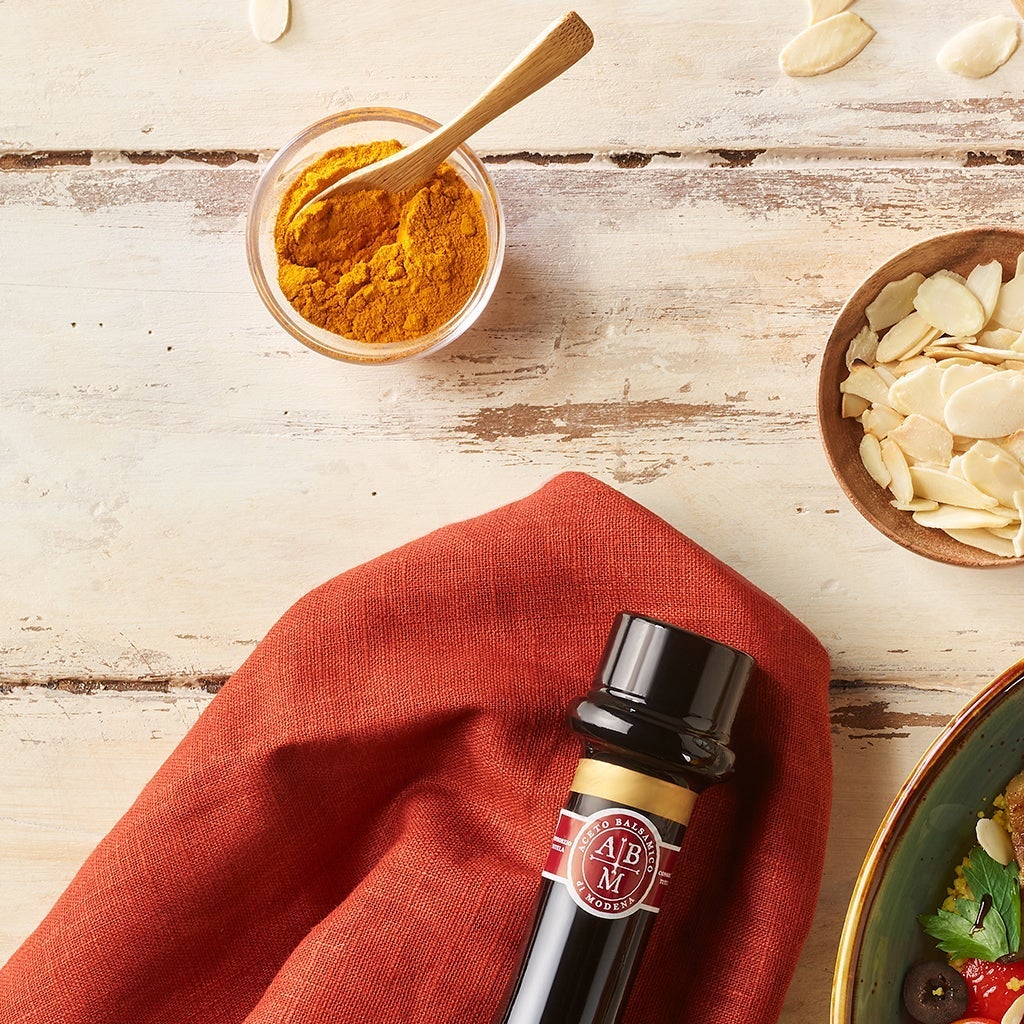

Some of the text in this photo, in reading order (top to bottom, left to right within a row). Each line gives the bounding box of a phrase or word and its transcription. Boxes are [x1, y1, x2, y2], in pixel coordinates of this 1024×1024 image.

[578, 818, 656, 873] ACETO BALSAMICO
[576, 880, 635, 912] DI MODENA
